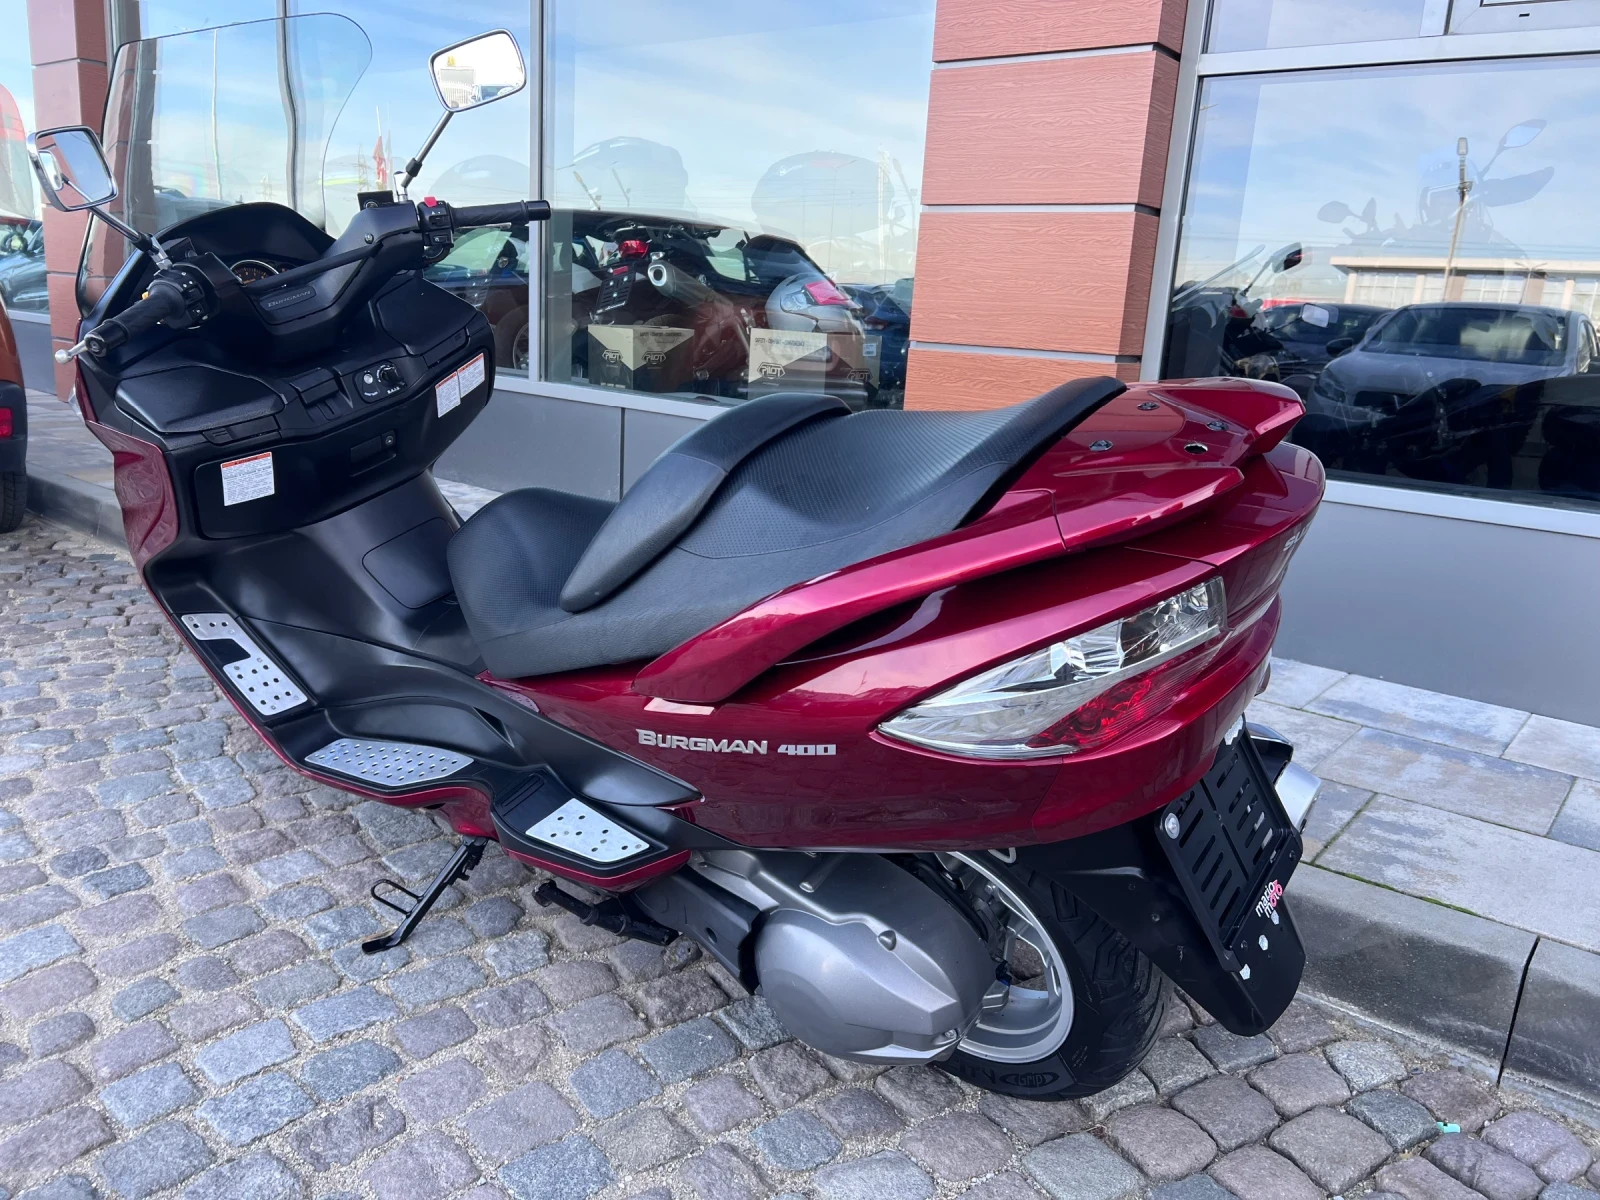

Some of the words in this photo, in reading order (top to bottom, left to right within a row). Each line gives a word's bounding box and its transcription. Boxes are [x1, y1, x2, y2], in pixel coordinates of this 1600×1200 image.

[636, 728, 768, 755] BURGMAN
[777, 743, 837, 756] 400
[1255, 881, 1275, 917] mario
[1264, 883, 1283, 918] moto
